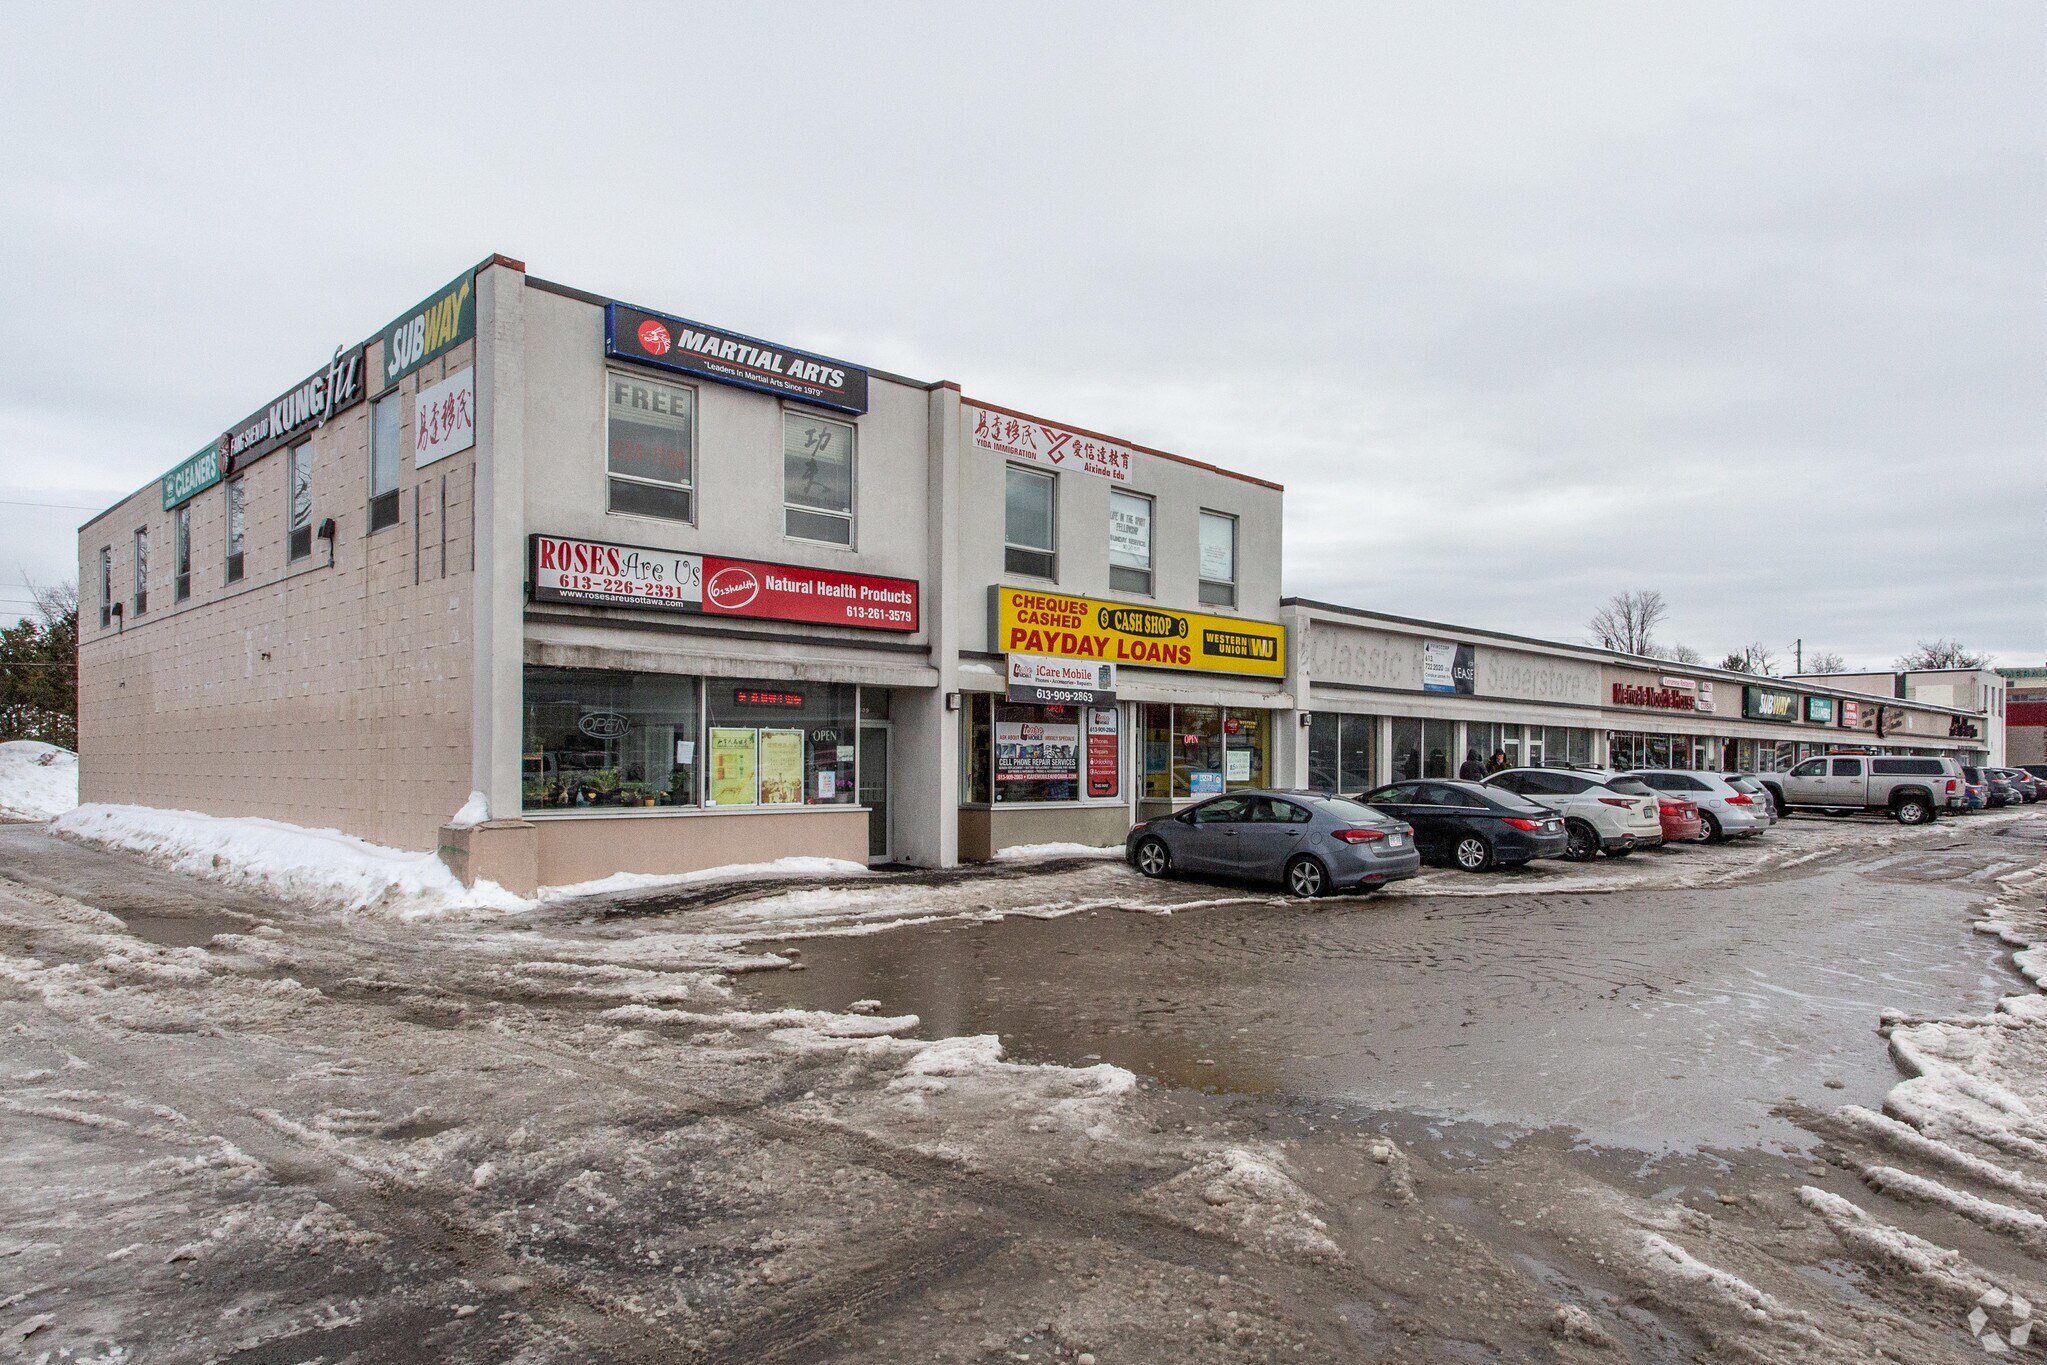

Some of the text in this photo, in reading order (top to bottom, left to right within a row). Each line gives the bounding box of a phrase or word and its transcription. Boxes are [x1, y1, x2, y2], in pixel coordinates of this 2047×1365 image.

[388, 279, 469, 379] SUBWAY
[678, 329, 845, 388] MARTIAL ARTS
[745, 372, 768, 384] Martial
[770, 378, 783, 388] Arts
[784, 381, 802, 393] Since
[270, 376, 324, 439] KUNG
[615, 382, 685, 418] FREE
[976, 438, 1037, 460] YIDA IMMIGRATION
[175, 451, 216, 497] CLEANERS
[1084, 462, 1125, 480] Aixinda Edu
[540, 538, 700, 587] ROSES Are Us
[559, 574, 683, 599] 613-226-2331
[765, 575, 912, 604] Natural Health Products
[559, 590, 684, 608] www.rosesareusottawa.com
[1012, 594, 1088, 615] CHEQUES
[846, 606, 912, 622] 613-261-3579
[1017, 610, 1081, 629] CASHED
[1010, 627, 1191, 665] PAYDAY LOANS
[1206, 633, 1247, 645] WESTERN
[1251, 638, 1273, 658] WU
[1219, 644, 1247, 655] UNION
[1036, 665, 1092, 680] iCare Mobile
[1454, 667, 1474, 680] LEASE
[1036, 688, 1093, 702] 613-909-2863
[1759, 693, 1791, 715] SUBWAY
[582, 717, 630, 733] OPEN
[813, 730, 837, 741] OPEN
[1184, 735, 1198, 743] OPEN
[999, 758, 1012, 766] CELL
